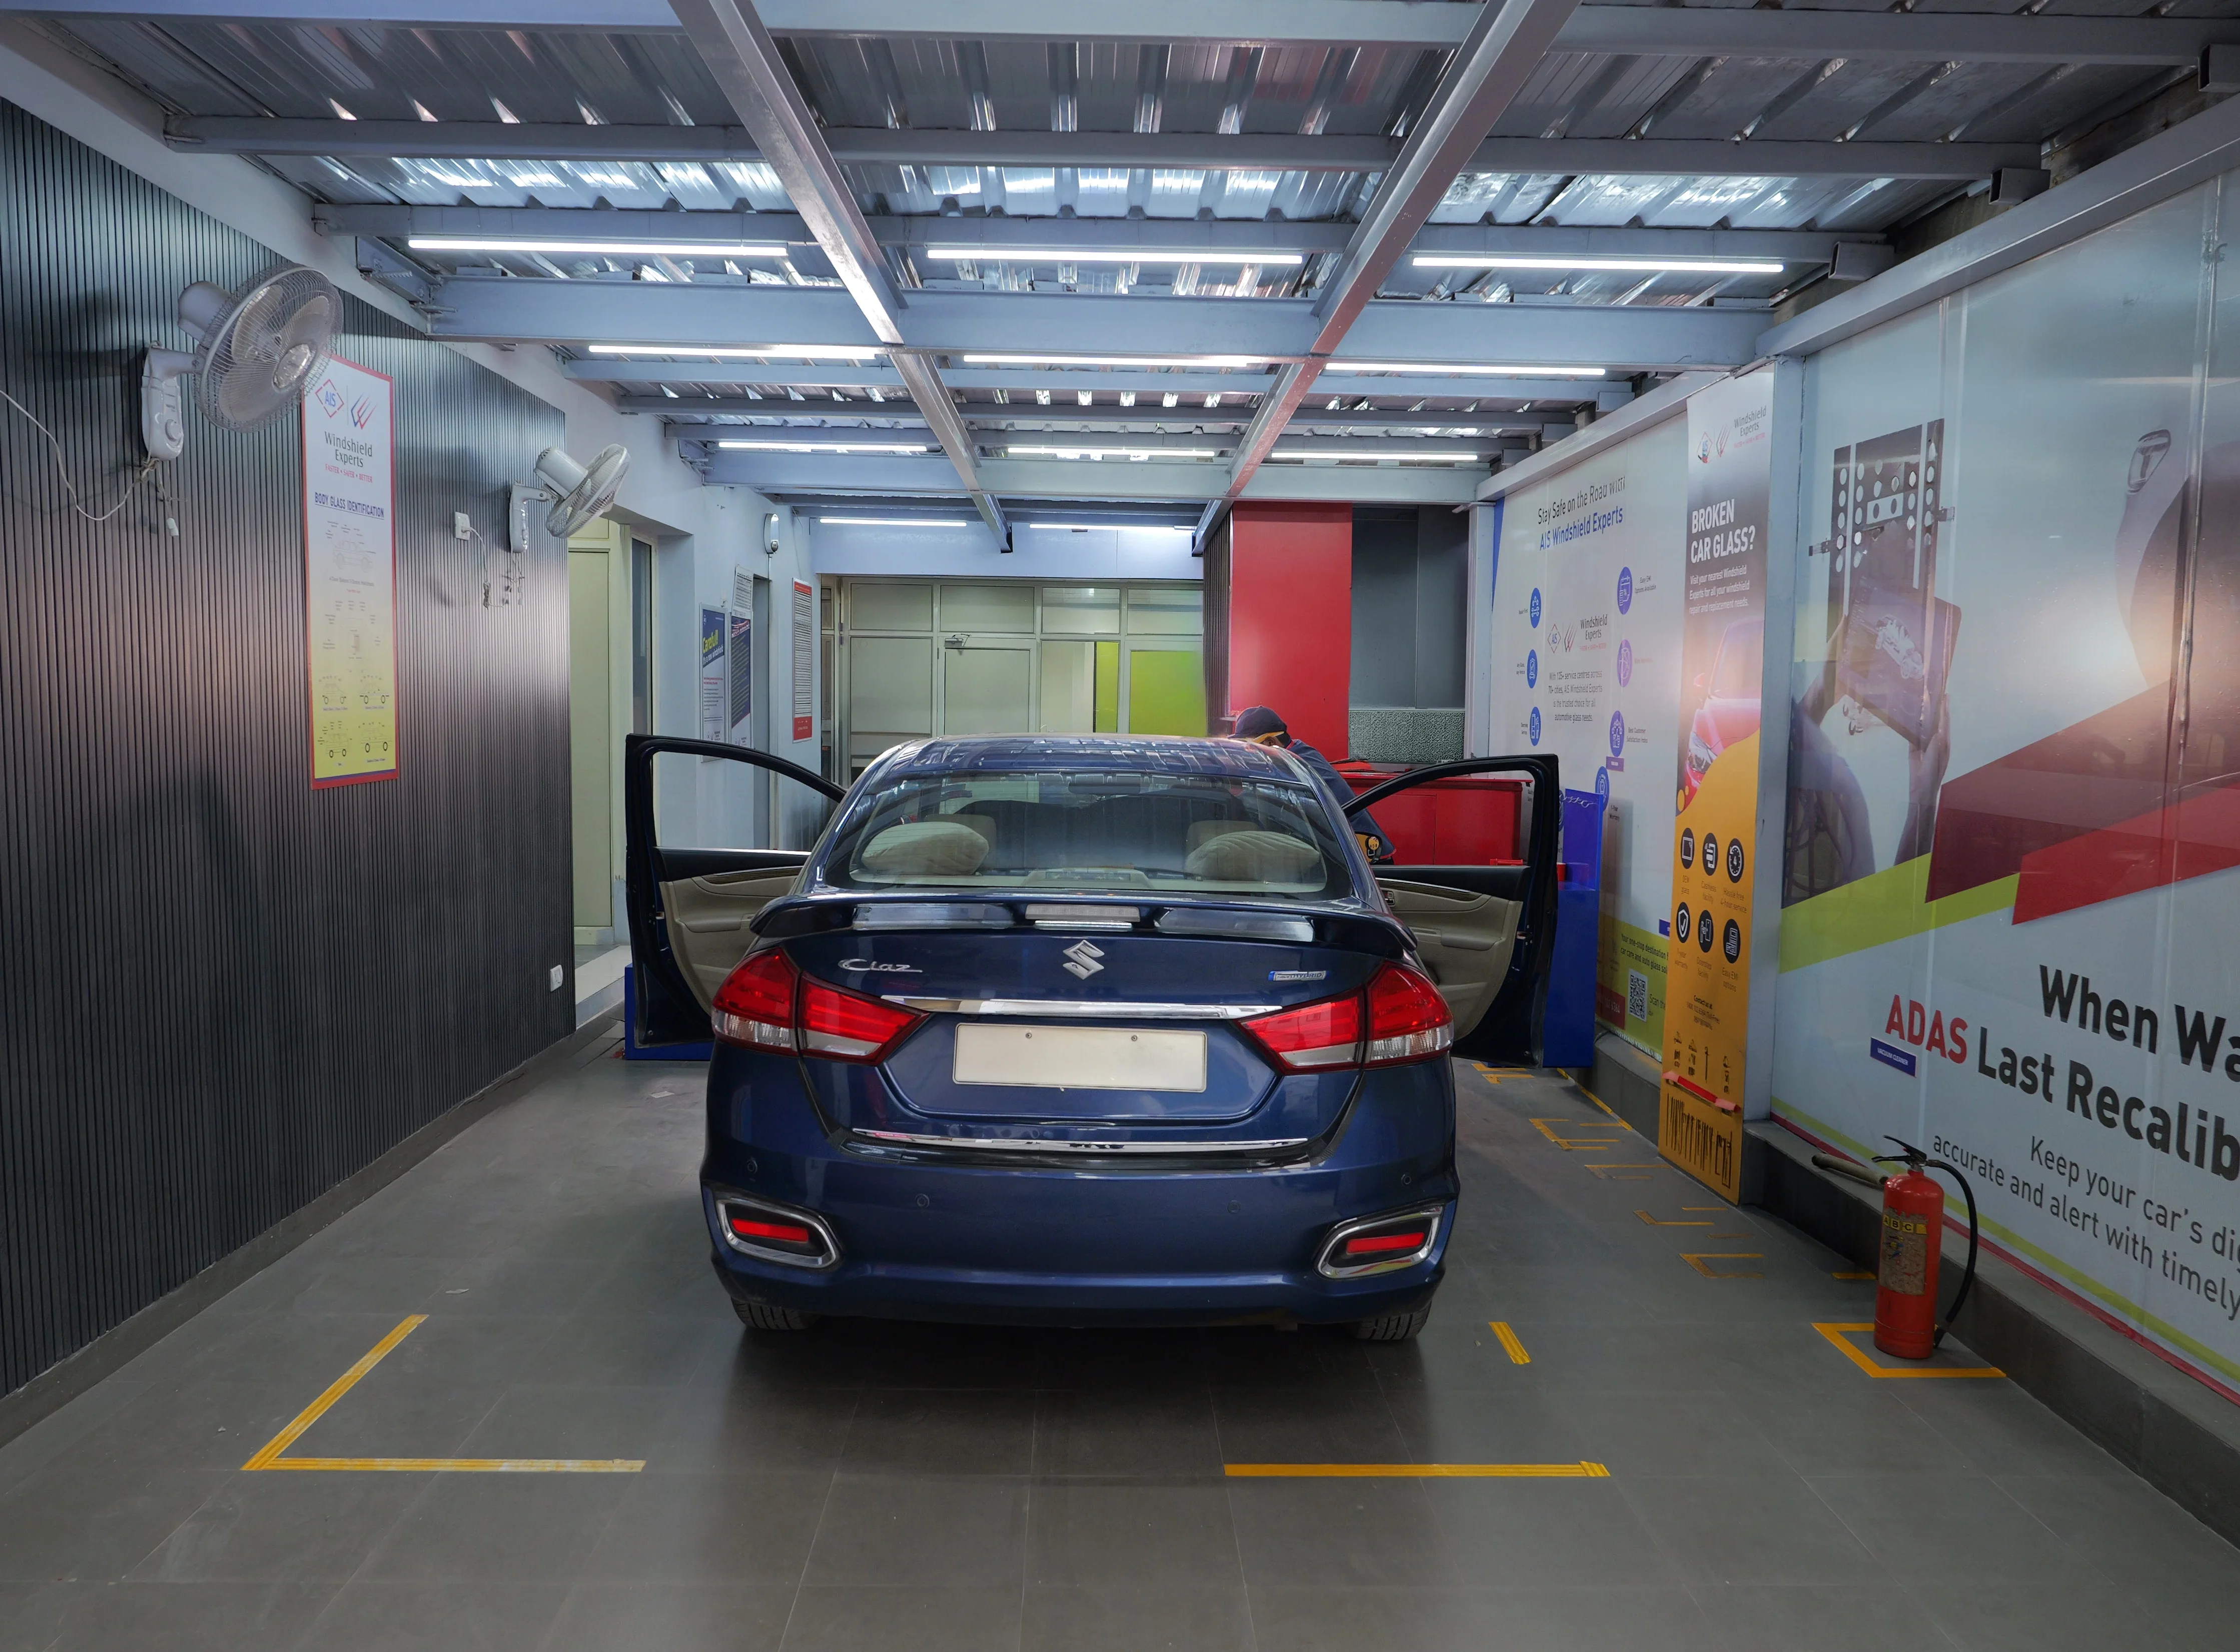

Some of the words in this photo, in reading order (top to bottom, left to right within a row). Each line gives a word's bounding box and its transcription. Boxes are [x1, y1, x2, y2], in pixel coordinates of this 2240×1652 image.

[325, 390, 336, 407] AIS
[1734, 405, 1767, 428] Windshield
[1740, 422, 1759, 437] Experts
[324, 431, 372, 457] Windshield
[335, 449, 363, 468] Experts
[325, 463, 339, 474] FASTER
[344, 469, 355, 478] SAFER
[359, 473, 373, 483] BETTER
[315, 492, 329, 505] BODY
[330, 496, 345, 509] GLASS
[347, 500, 384, 518] IDENTIFICATION
[1538, 508, 1552, 525] Stay
[1553, 498, 1566, 518] Safe
[1568, 497, 1575, 513] on
[1577, 490, 1588, 508] the
[1692, 498, 1735, 534] BROKEN
[1540, 530, 1551, 551] AIS
[1553, 514, 1591, 546] Windshield
[1593, 506, 1623, 534] Experts
[1691, 536, 1711, 564] CAR
[1713, 525, 1756, 558] GLASS?
[1690, 574, 1699, 584] Visit
[1699, 574, 1708, 585] your
[1708, 570, 1723, 581] nearest
[1723, 564, 1747, 578] Windshield
[1690, 590, 1704, 601] Experts
[1716, 586, 1726, 597] your
[1726, 580, 1750, 593] windshield
[1689, 604, 1700, 616] repair
[1701, 602, 1709, 612] and
[1709, 599, 1734, 613] replacement
[1581, 614, 1608, 629] Windshield
[1585, 629, 1602, 641] Experts
[1565, 671, 1576, 679] service
[1571, 683, 1588, 693] Windshield
[1589, 683, 1602, 694] Experts
[1629, 938, 1645, 952] one-stop
[1645, 944, 1666, 960] destination
[838, 959, 923, 973] Ciaz
[1651, 960, 1661, 970] glass
[2039, 964, 2158, 1055] When
[2174, 1004, 2240, 1083] Wa
[1885, 994, 1968, 1064] ADAS
[1978, 1026, 2054, 1103] Last
[2066, 1060, 2240, 1182] Recalib
[2030, 1135, 2080, 1187] Keep
[2085, 1168, 2136, 1209] your
[2143, 1198, 2203, 1244] car's
[1933, 1135, 2005, 1187] accurate
[2009, 1175, 2044, 1209] and
[2049, 1195, 2099, 1239] alert
[2105, 1224, 2152, 1269] with
[2161, 1250, 2240, 1321] timely
